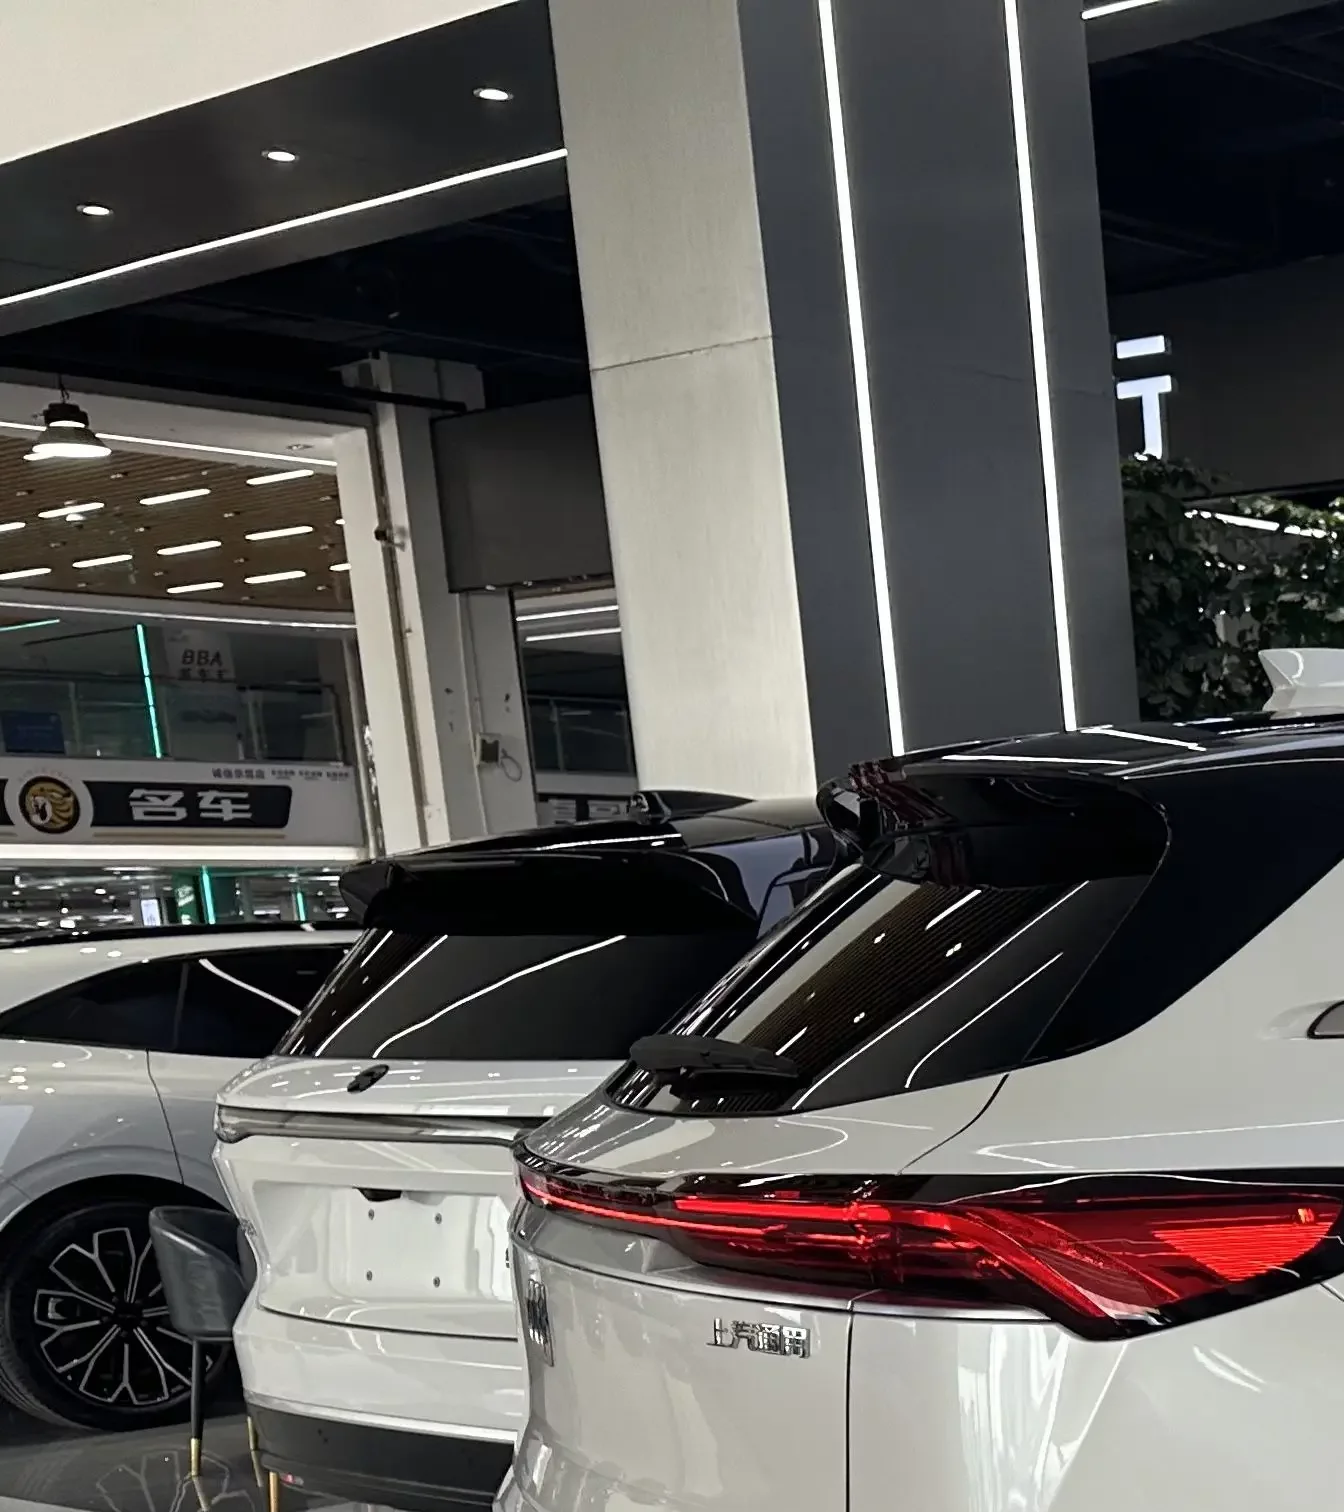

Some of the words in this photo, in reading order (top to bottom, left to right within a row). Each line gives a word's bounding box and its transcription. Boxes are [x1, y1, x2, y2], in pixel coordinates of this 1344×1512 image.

[181, 648, 223, 667] BBA
[129, 788, 253, 822] 名车
[706, 1317, 811, 1360] 上汽通用
